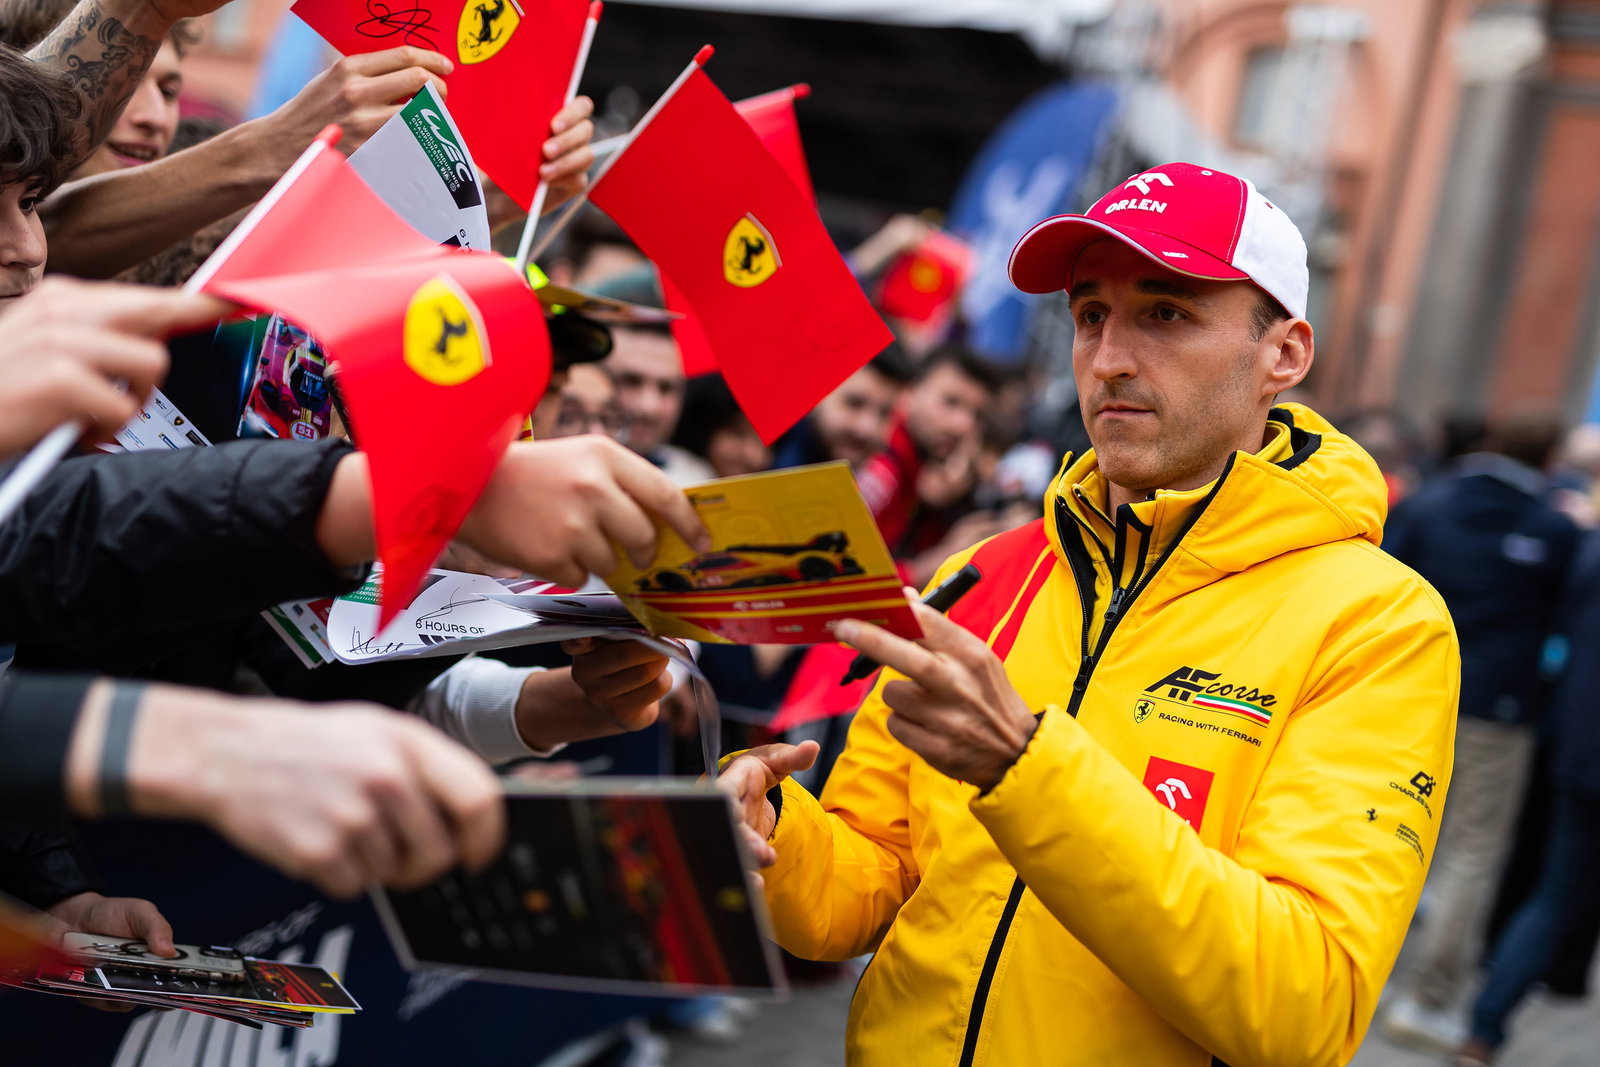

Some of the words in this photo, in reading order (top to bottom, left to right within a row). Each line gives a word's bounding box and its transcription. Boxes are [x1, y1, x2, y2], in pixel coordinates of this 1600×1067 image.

[411, 117, 445, 165] CHAMPIONSHIP
[413, 114, 423, 125] FIA
[422, 125, 438, 151] WORLD
[437, 149, 461, 189] ENDURANCE
[420, 108, 473, 182] WEC
[1105, 198, 1168, 214] ORLEN
[297, 425, 312, 438] 51
[415, 619, 422, 629] 6
[425, 620, 467, 634] HOURS
[469, 626, 485, 635] OF
[1205, 682, 1278, 707] corse
[1158, 712, 1194, 727] RACING
[1195, 721, 1220, 734] WITH
[1221, 727, 1262, 748] FERRARI
